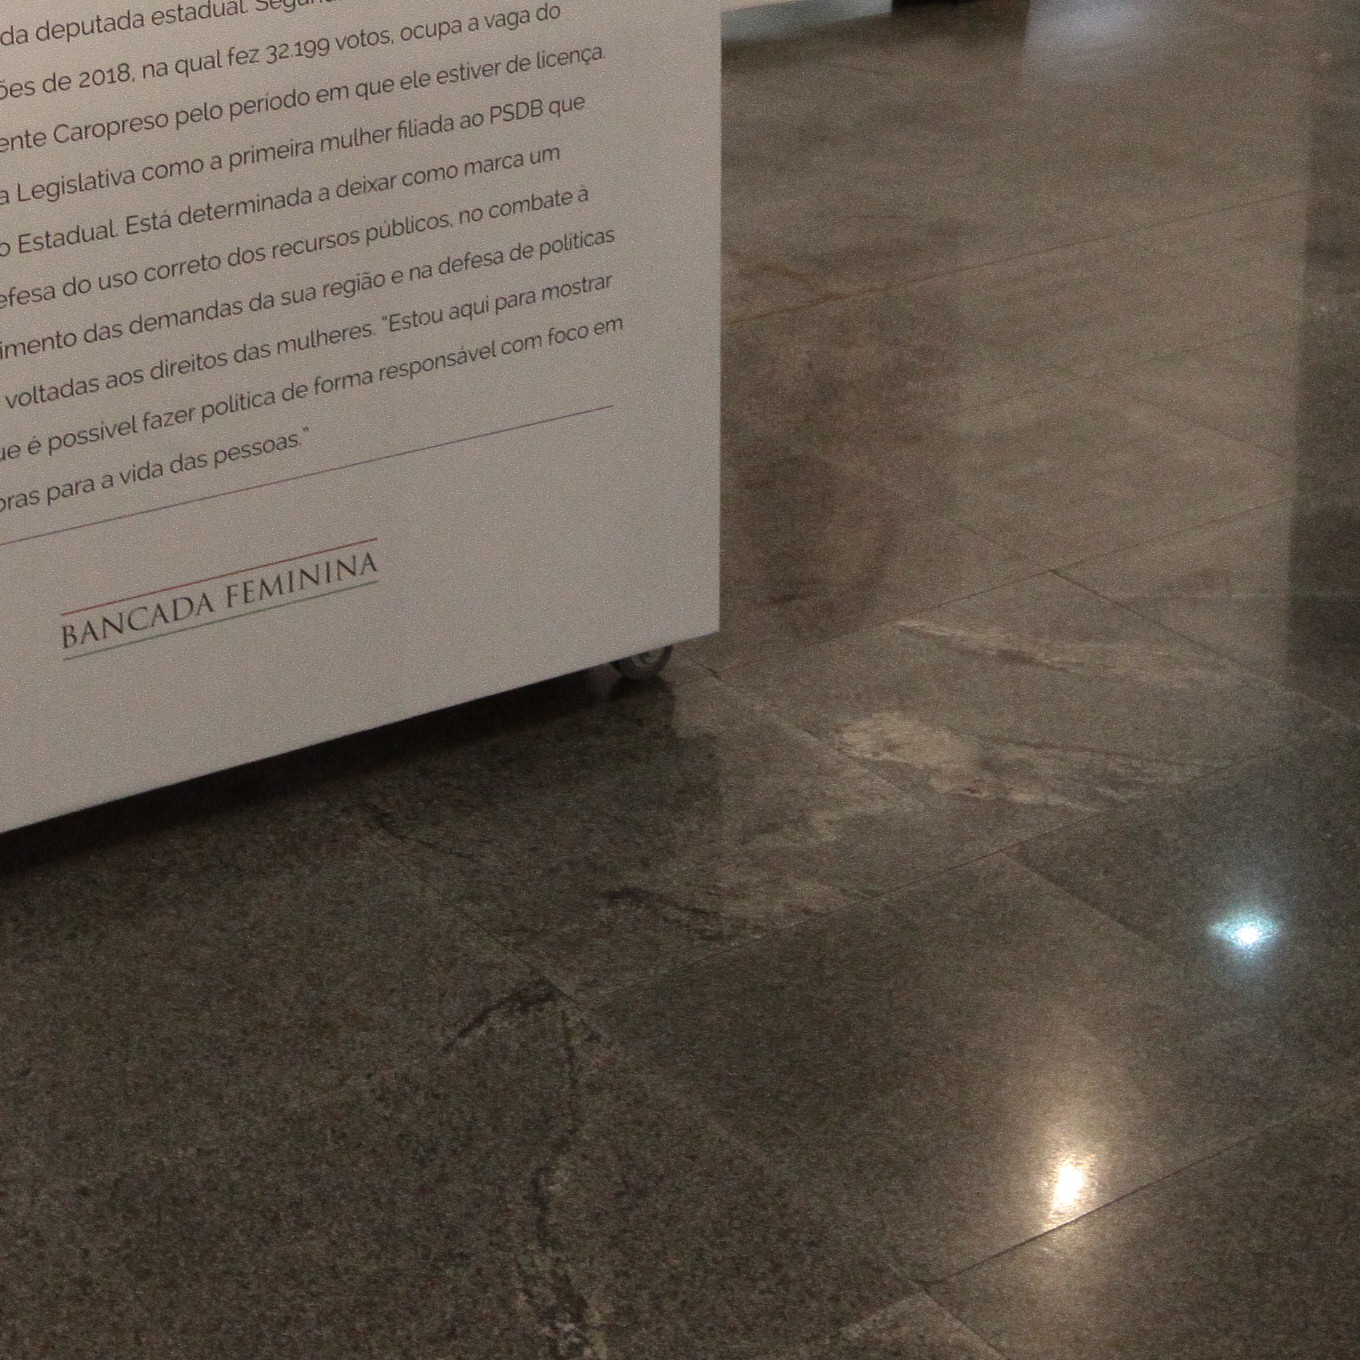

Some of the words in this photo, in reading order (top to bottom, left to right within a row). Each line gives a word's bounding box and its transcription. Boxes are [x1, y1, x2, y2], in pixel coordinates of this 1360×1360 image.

[40, 70, 73, 94] de
[77, 60, 136, 90] 2018,
[141, 59, 170, 80] na
[173, 47, 223, 79] qual
[226, 44, 260, 67] fez
[264, 36, 331, 67] 32.199
[334, 27, 396, 52] votos,
[398, 17, 463, 42] ocupa
[466, 15, 480, 32] a
[482, 7, 531, 32] vaga
[534, 0, 562, 23] do
[15, 167, 136, 204] Legislativa
[140, 156, 205, 182] como
[208, 153, 223, 172] a
[227, 138, 315, 173] primeira
[318, 125, 393, 153] mulher
[395, 112, 455, 140] filiada
[458, 110, 485, 131] ao
[488, 96, 544, 125] PSDB
[546, 93, 586, 119] que
[60, 274, 92, 298] do
[96, 268, 139, 292] uso
[141, 252, 223, 283] correto
[225, 244, 267, 268] dos
[270, 228, 361, 260] recursos
[364, 212, 454, 248] públicos,
[457, 205, 484, 225] no
[486, 188, 574, 220] combate
[576, 183, 590, 204] à
[3, 375, 101, 410] voltadas
[103, 367, 145, 390] aos
[148, 350, 229, 382] direitos
[231, 341, 272, 365] das
[275, 321, 376, 356] mulheres.
[447, 293, 490, 322] aqui
[493, 288, 537, 316] para
[540, 272, 613, 302] mostrar
[62, 591, 215, 650] BANCADA
[225, 551, 379, 609] FEMININA
